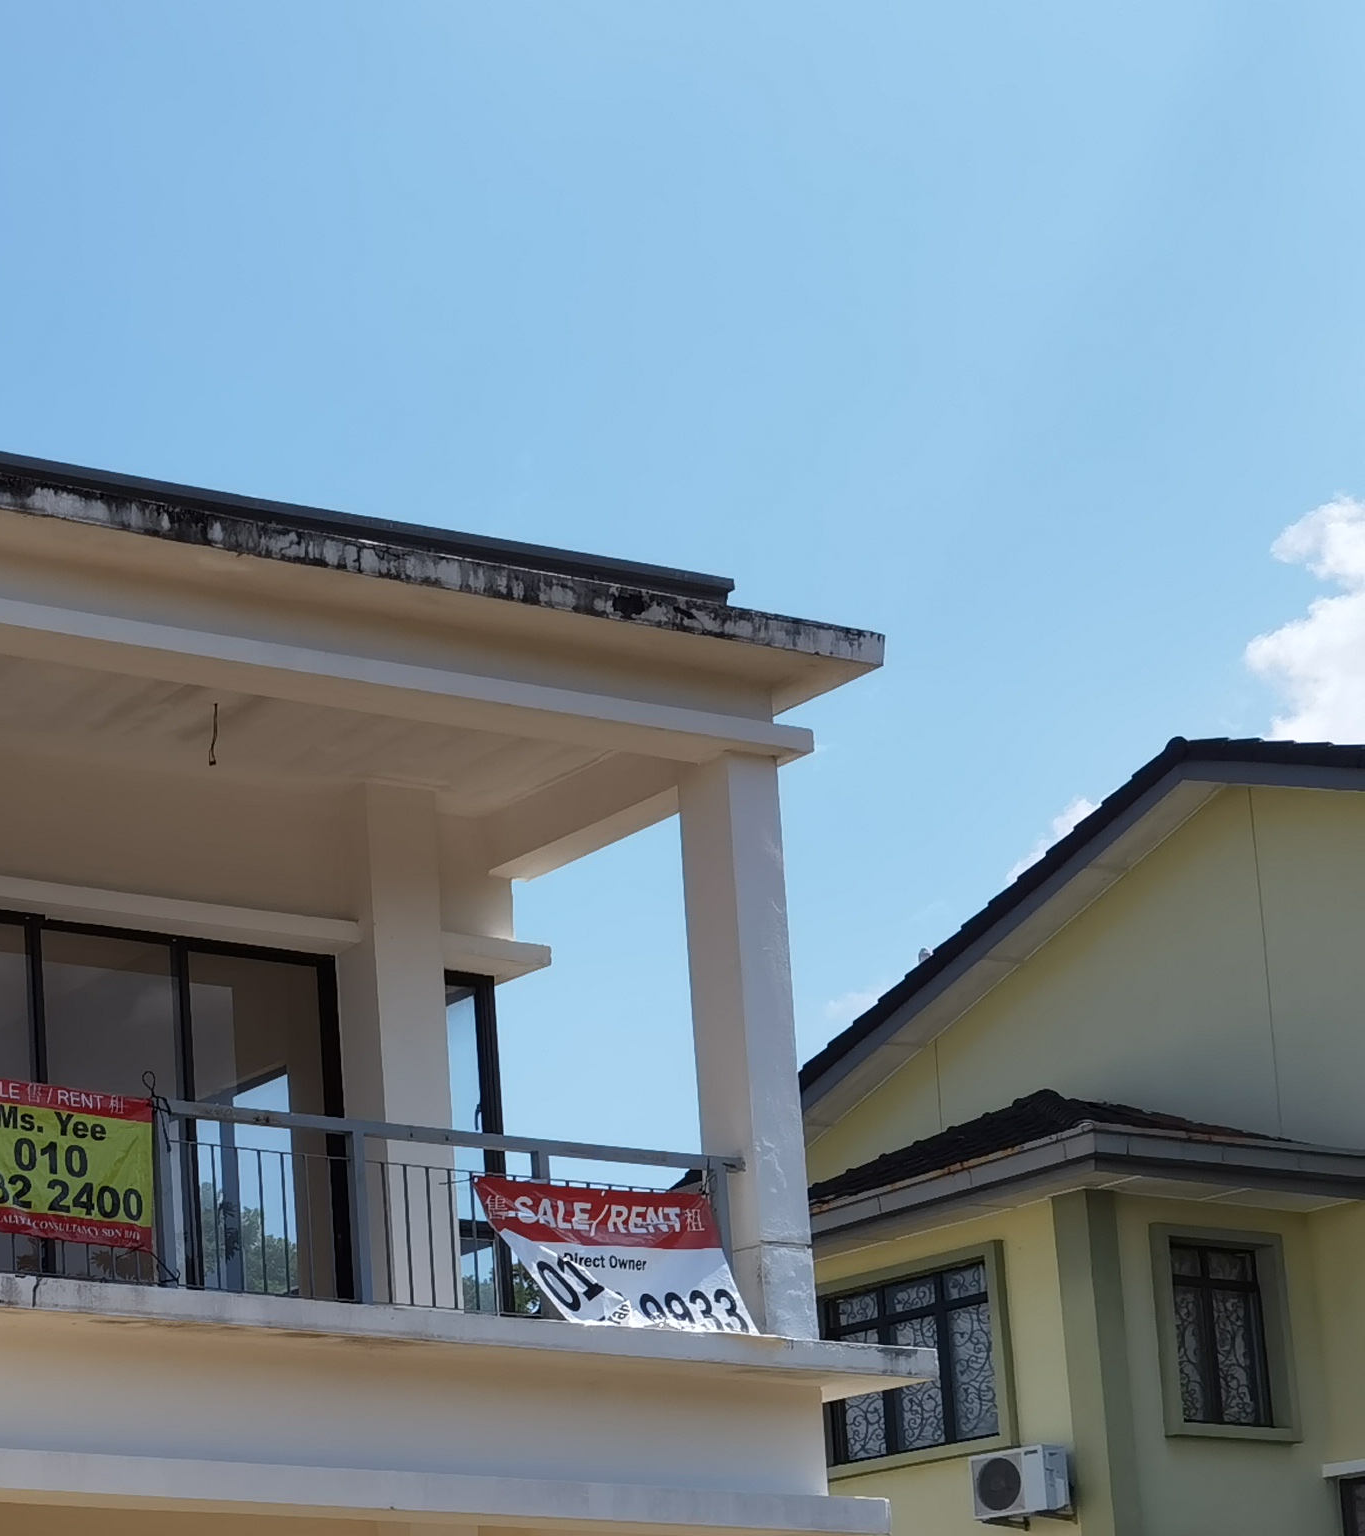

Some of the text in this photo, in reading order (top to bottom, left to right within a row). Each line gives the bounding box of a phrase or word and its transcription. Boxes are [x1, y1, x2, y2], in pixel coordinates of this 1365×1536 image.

[57, 1090, 105, 1110] RENT
[54, 1111, 107, 1141] Yee
[14, 1137, 88, 1179] 010
[47, 1178, 144, 1222] 2400
[485, 1194, 507, 1220] 售
[684, 1208, 705, 1232] 租
[32, 1220, 100, 1236] CONSULTANCY
[101, 1227, 122, 1239] SDN
[609, 1255, 647, 1271] Owner
